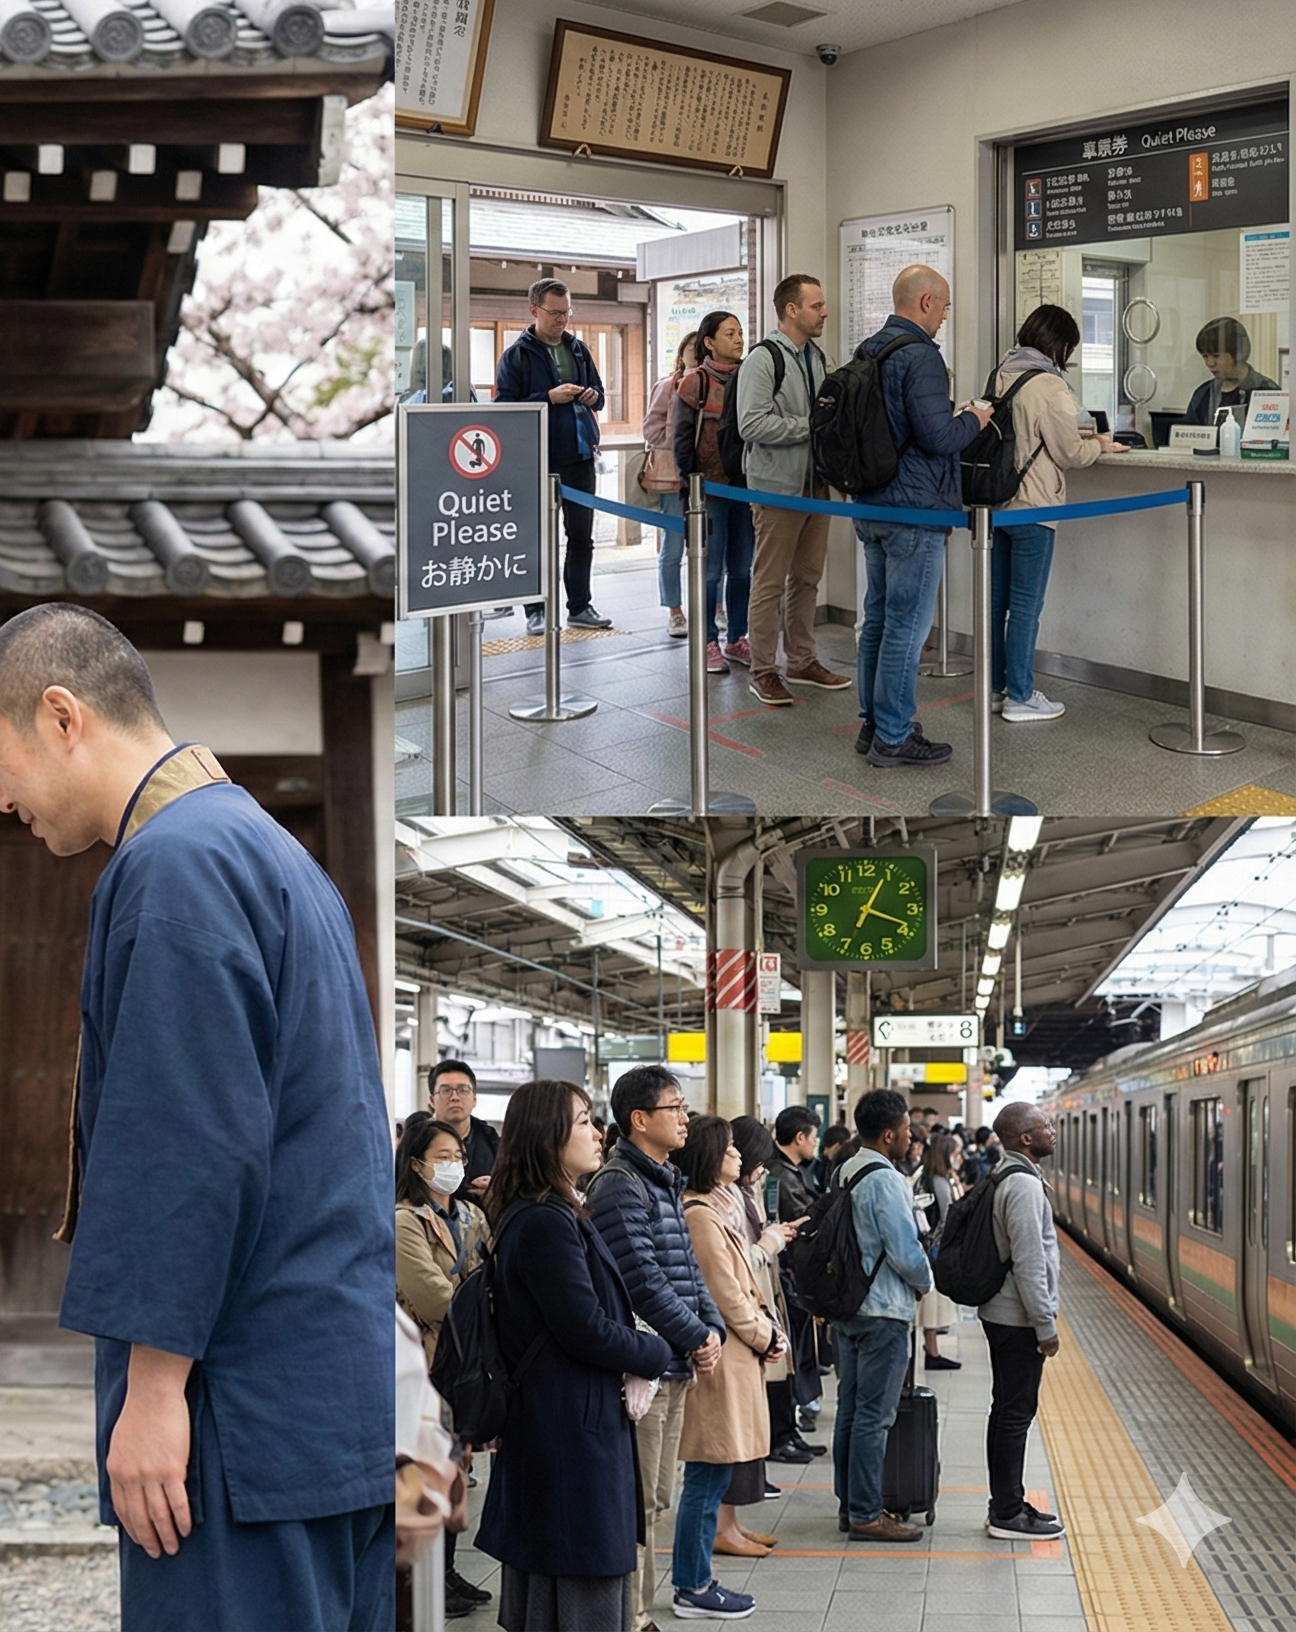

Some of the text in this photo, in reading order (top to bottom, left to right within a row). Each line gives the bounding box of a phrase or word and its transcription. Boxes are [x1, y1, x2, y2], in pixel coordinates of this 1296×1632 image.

[1141, 131, 1174, 148] Quiet
[438, 489, 512, 518] Quiet
[433, 520, 518, 546] Please
[421, 554, 527, 588] お静かに
[840, 871, 851, 881] 11
[857, 865, 875, 876] 12
[886, 869, 891, 880] 1
[824, 884, 840, 895] 10
[899, 883, 909, 894] 2
[816, 904, 827, 916] 9
[907, 903, 918, 915] 3
[824, 923, 836, 936] 8
[841, 938, 851, 949] 7
[860, 943, 872, 955] 6
[881, 938, 892, 950] 5
[960, 1021, 972, 1038] 8
